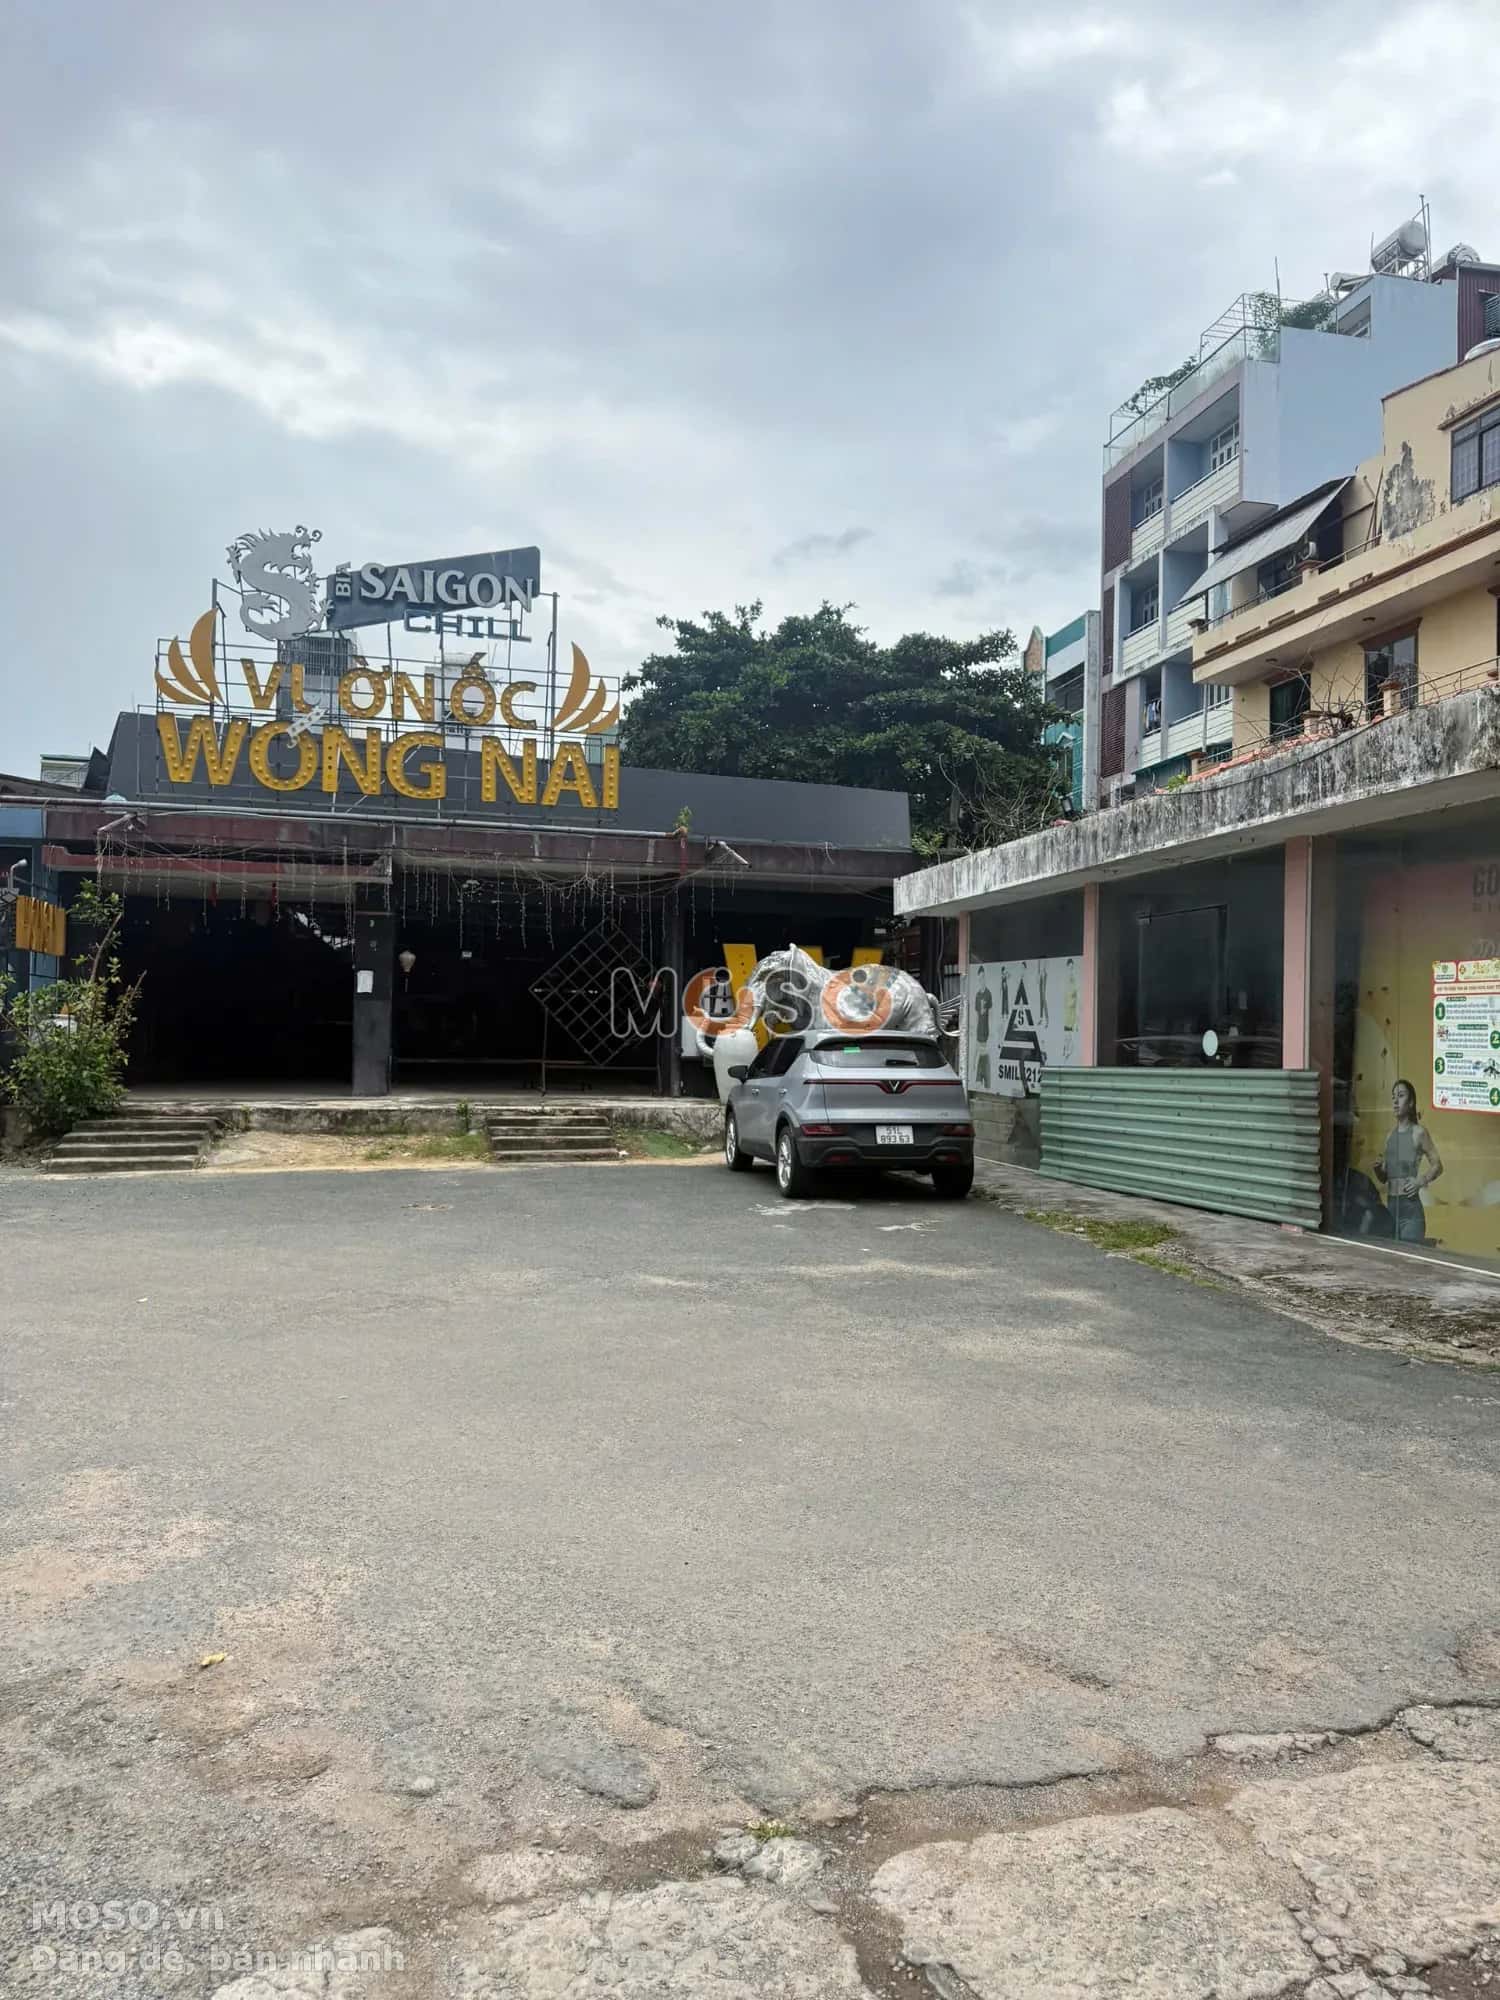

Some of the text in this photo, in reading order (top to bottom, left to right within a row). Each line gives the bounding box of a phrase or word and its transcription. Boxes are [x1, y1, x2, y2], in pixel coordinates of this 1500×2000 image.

[335, 561, 351, 597] BIA
[360, 562, 534, 613] SAIGON
[404, 609, 532, 642] CHILL
[451, 652, 537, 730] ỐC
[157, 712, 620, 809] WONG NAI
